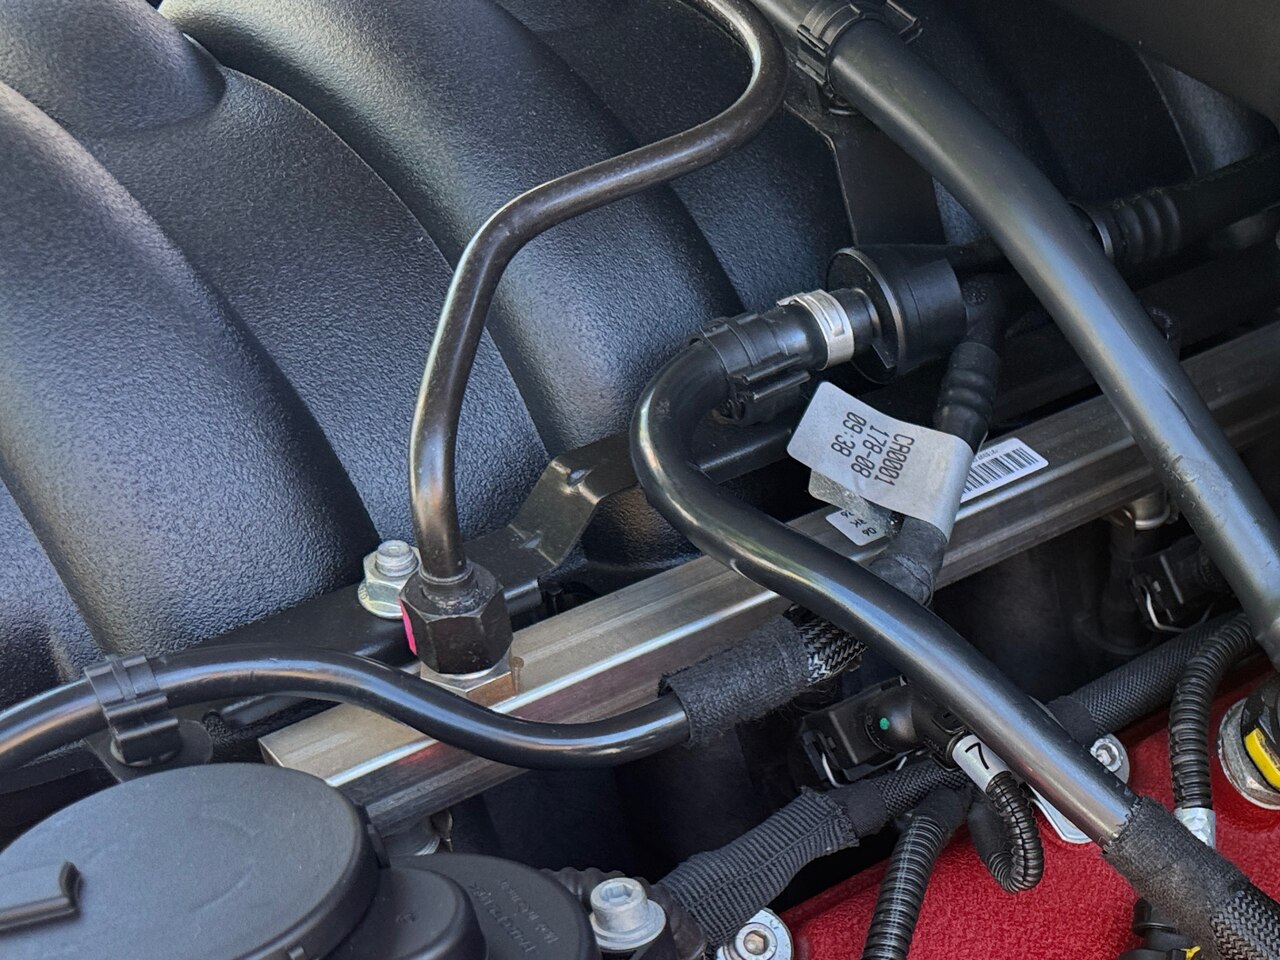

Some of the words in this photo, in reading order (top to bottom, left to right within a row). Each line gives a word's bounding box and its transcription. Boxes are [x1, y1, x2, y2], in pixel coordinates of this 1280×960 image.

[831, 411, 867, 457] 09:38
[851, 424, 890, 479] 178-08
[874, 434, 915, 487] CA0001
[965, 742, 990, 770] 7
